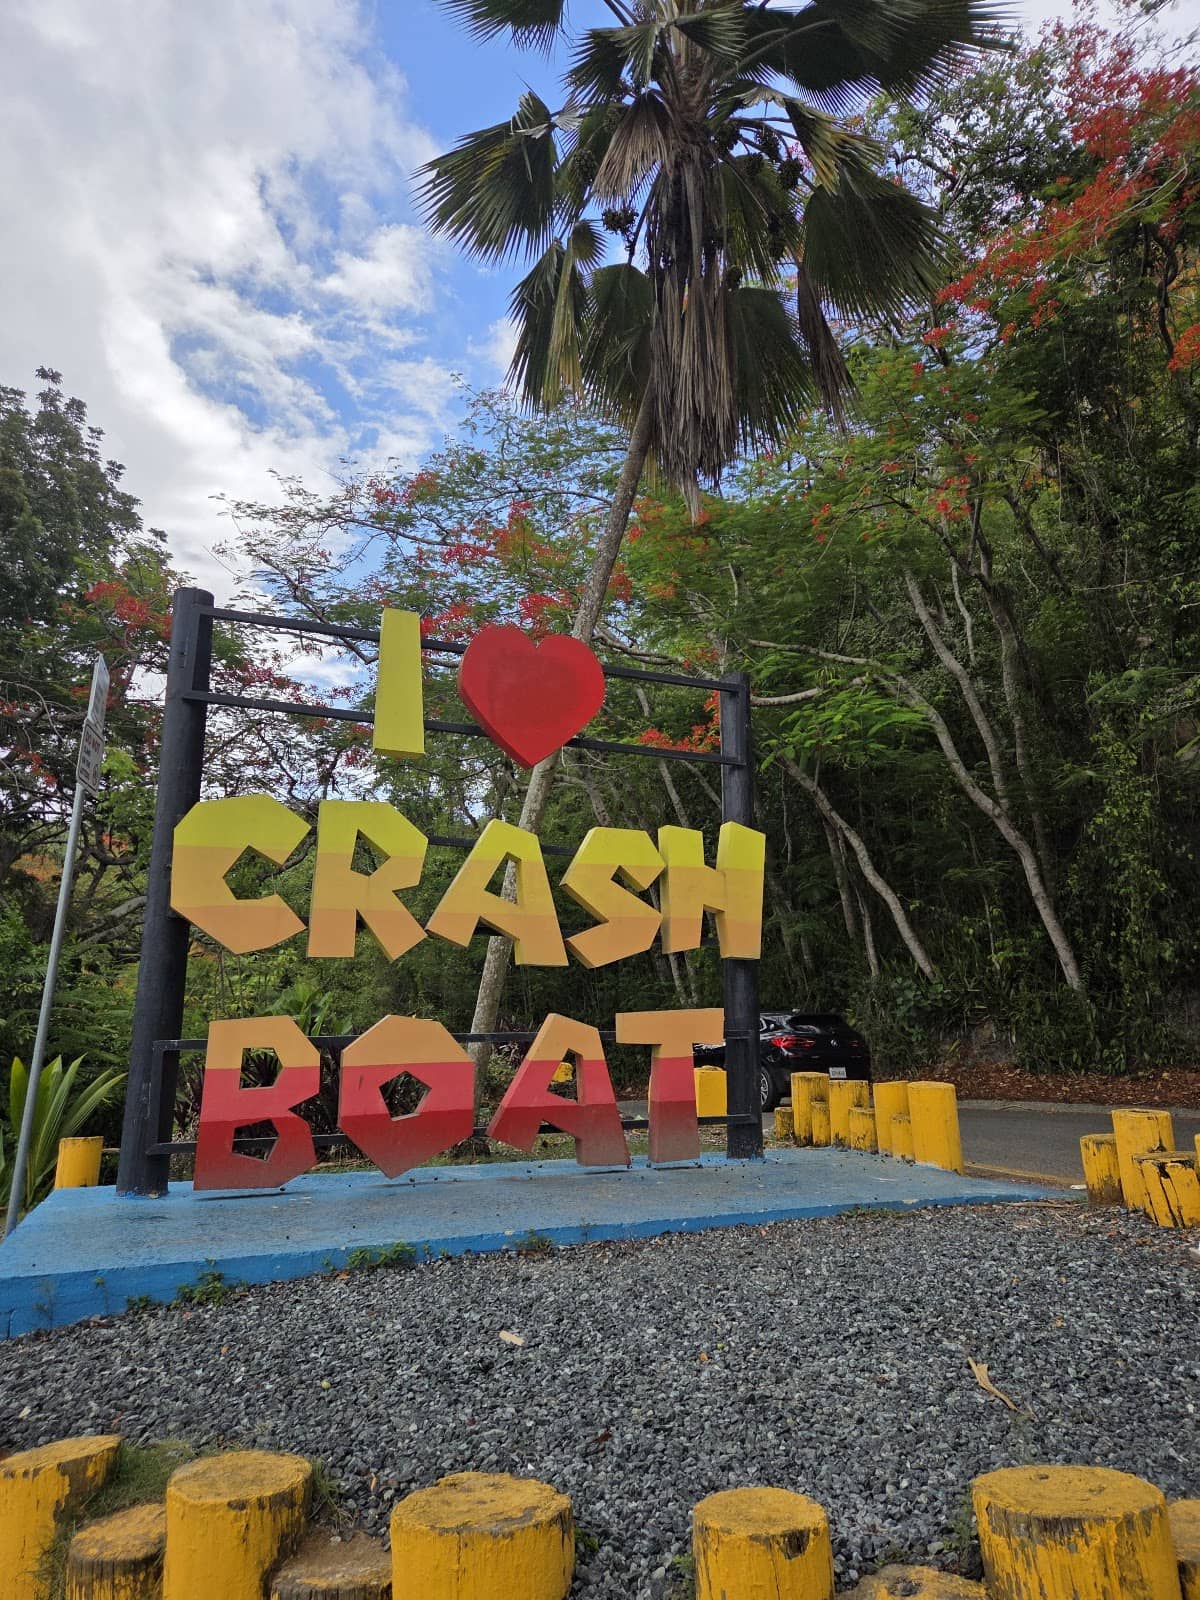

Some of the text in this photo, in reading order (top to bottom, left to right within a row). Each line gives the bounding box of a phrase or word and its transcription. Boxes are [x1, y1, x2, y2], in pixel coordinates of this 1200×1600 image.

[373, 608, 425, 757] I
[170, 794, 766, 968] CRASH
[193, 1008, 725, 1190] BOAT
